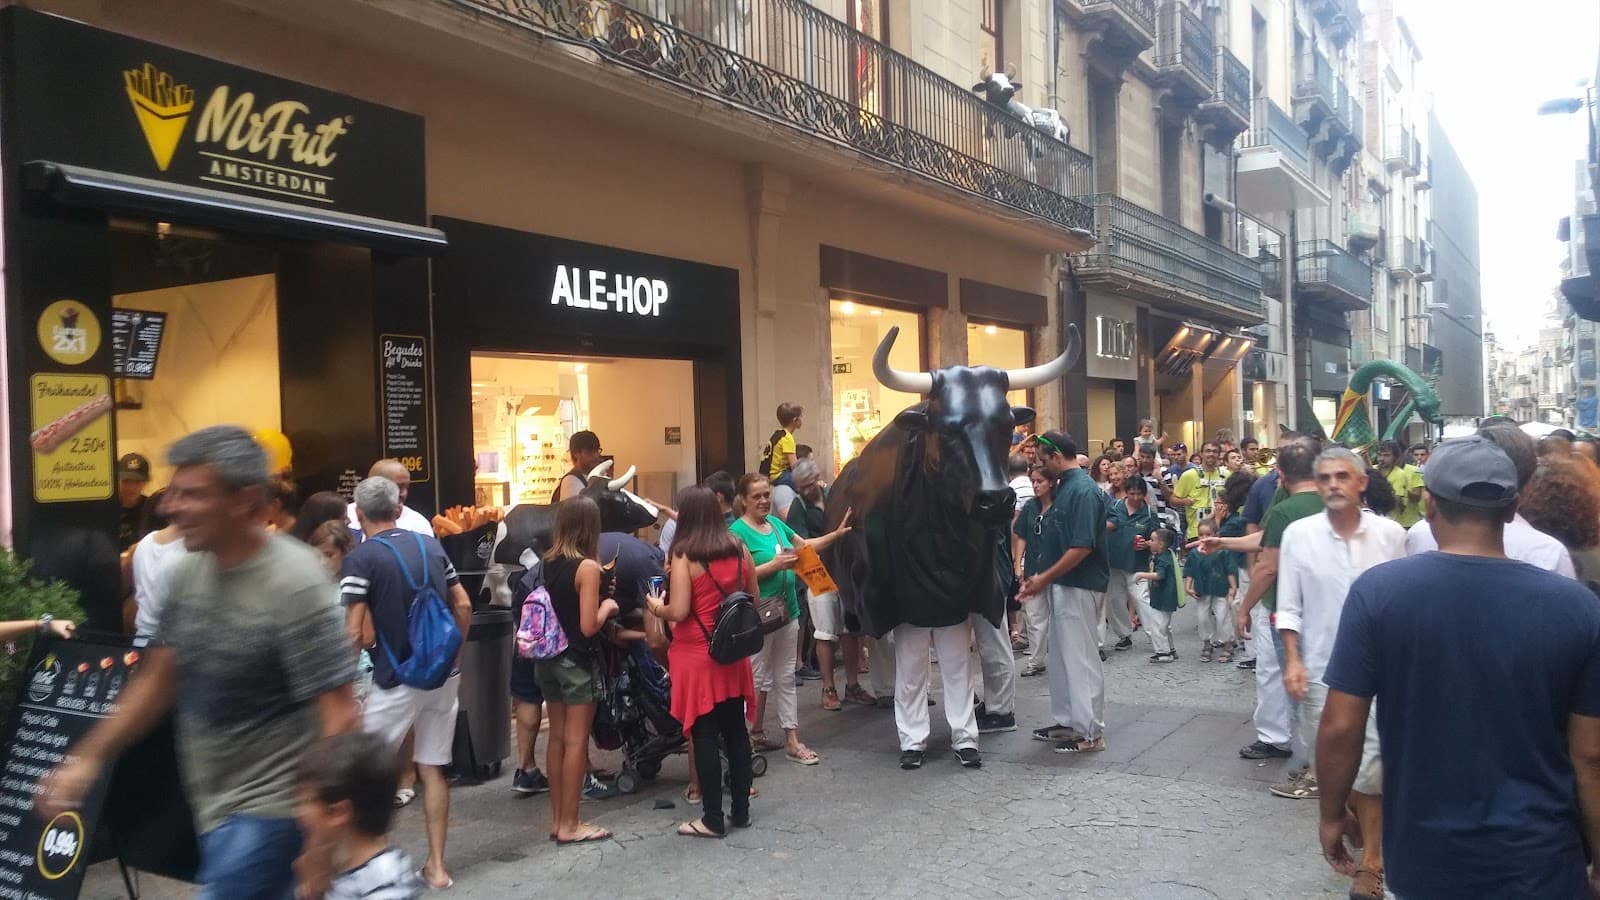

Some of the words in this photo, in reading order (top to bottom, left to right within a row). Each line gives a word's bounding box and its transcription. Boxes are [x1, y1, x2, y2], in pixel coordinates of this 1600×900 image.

[195, 85, 348, 167] MrFrit
[210, 160, 327, 195] AMSTERDAM
[550, 264, 669, 317] ALE-HOP
[384, 340, 423, 363] Begudes
[401, 357, 422, 368] Drinks
[70, 437, 105, 454] 2,50€
